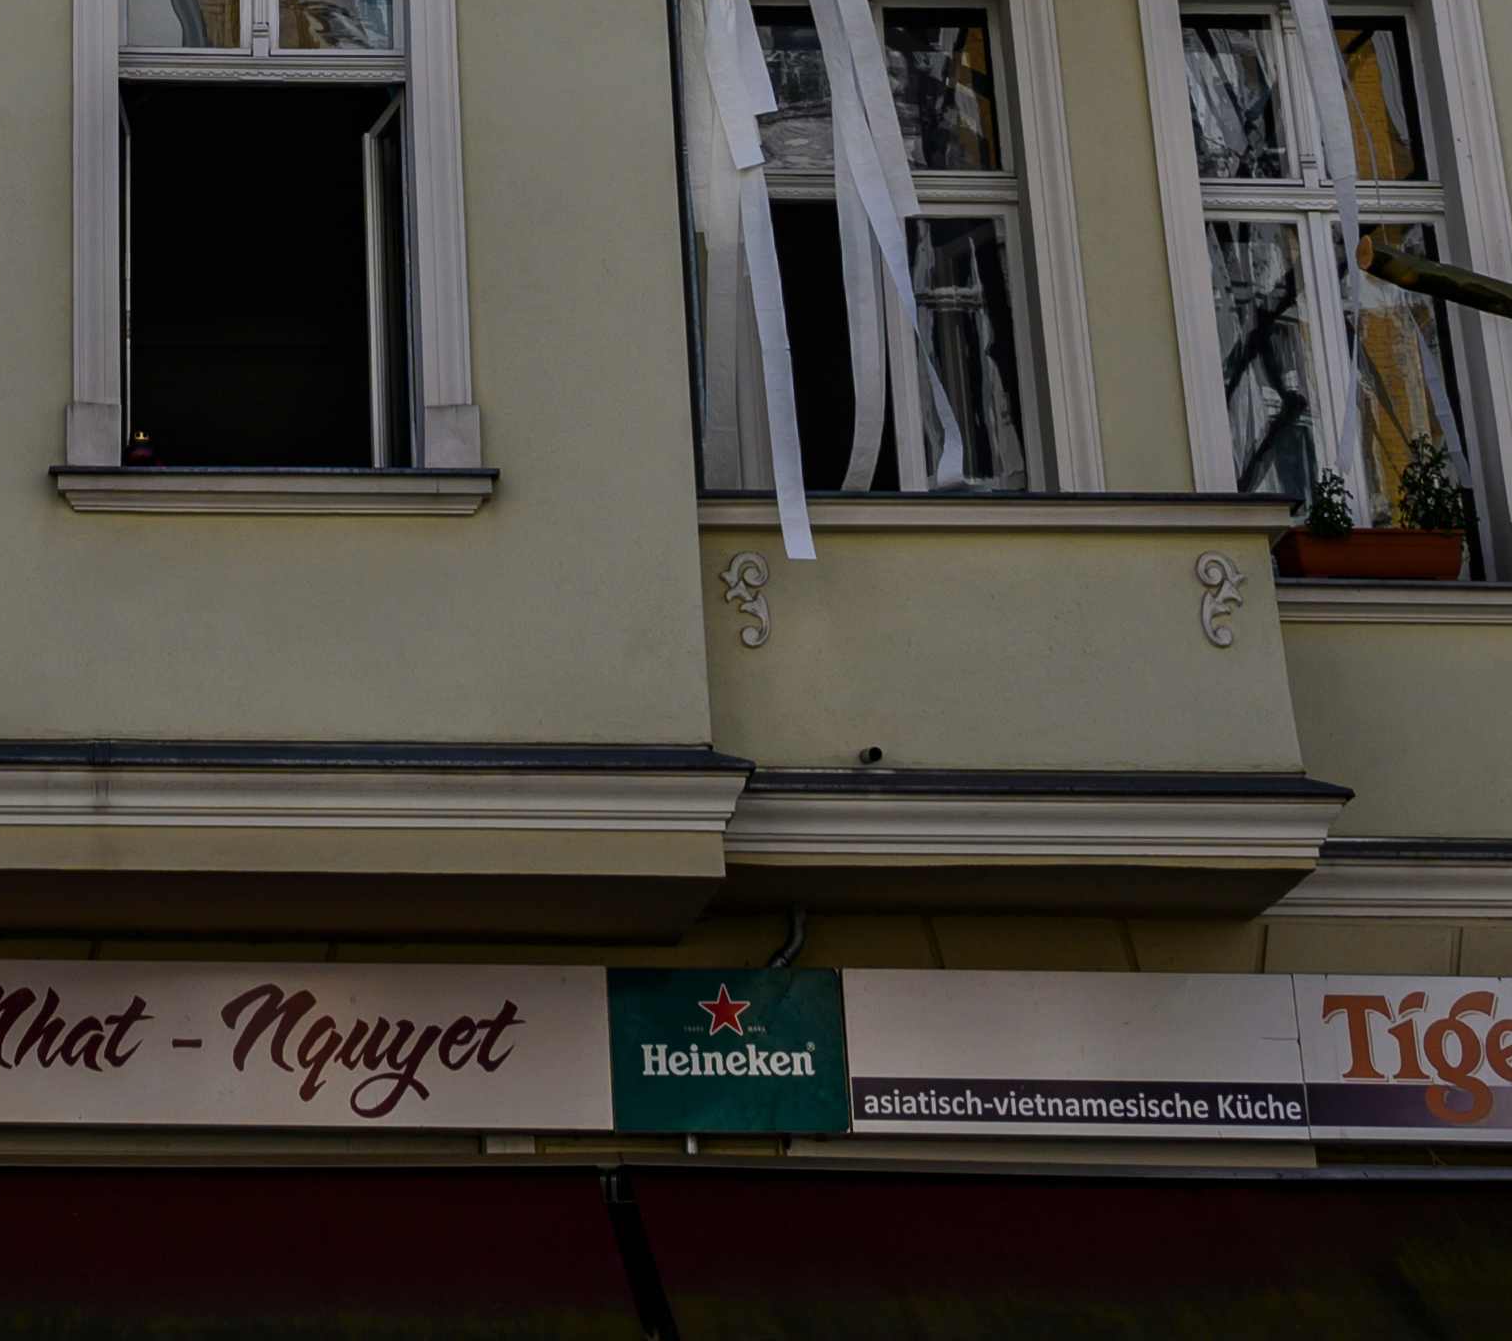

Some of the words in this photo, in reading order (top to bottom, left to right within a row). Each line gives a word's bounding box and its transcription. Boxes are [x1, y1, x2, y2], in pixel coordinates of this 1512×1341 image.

[640, 1043, 816, 1076] Heineken
[863, 1088, 1209, 1120] asiatisch-vietnamesische
[1217, 1093, 1302, 1122] Küche
